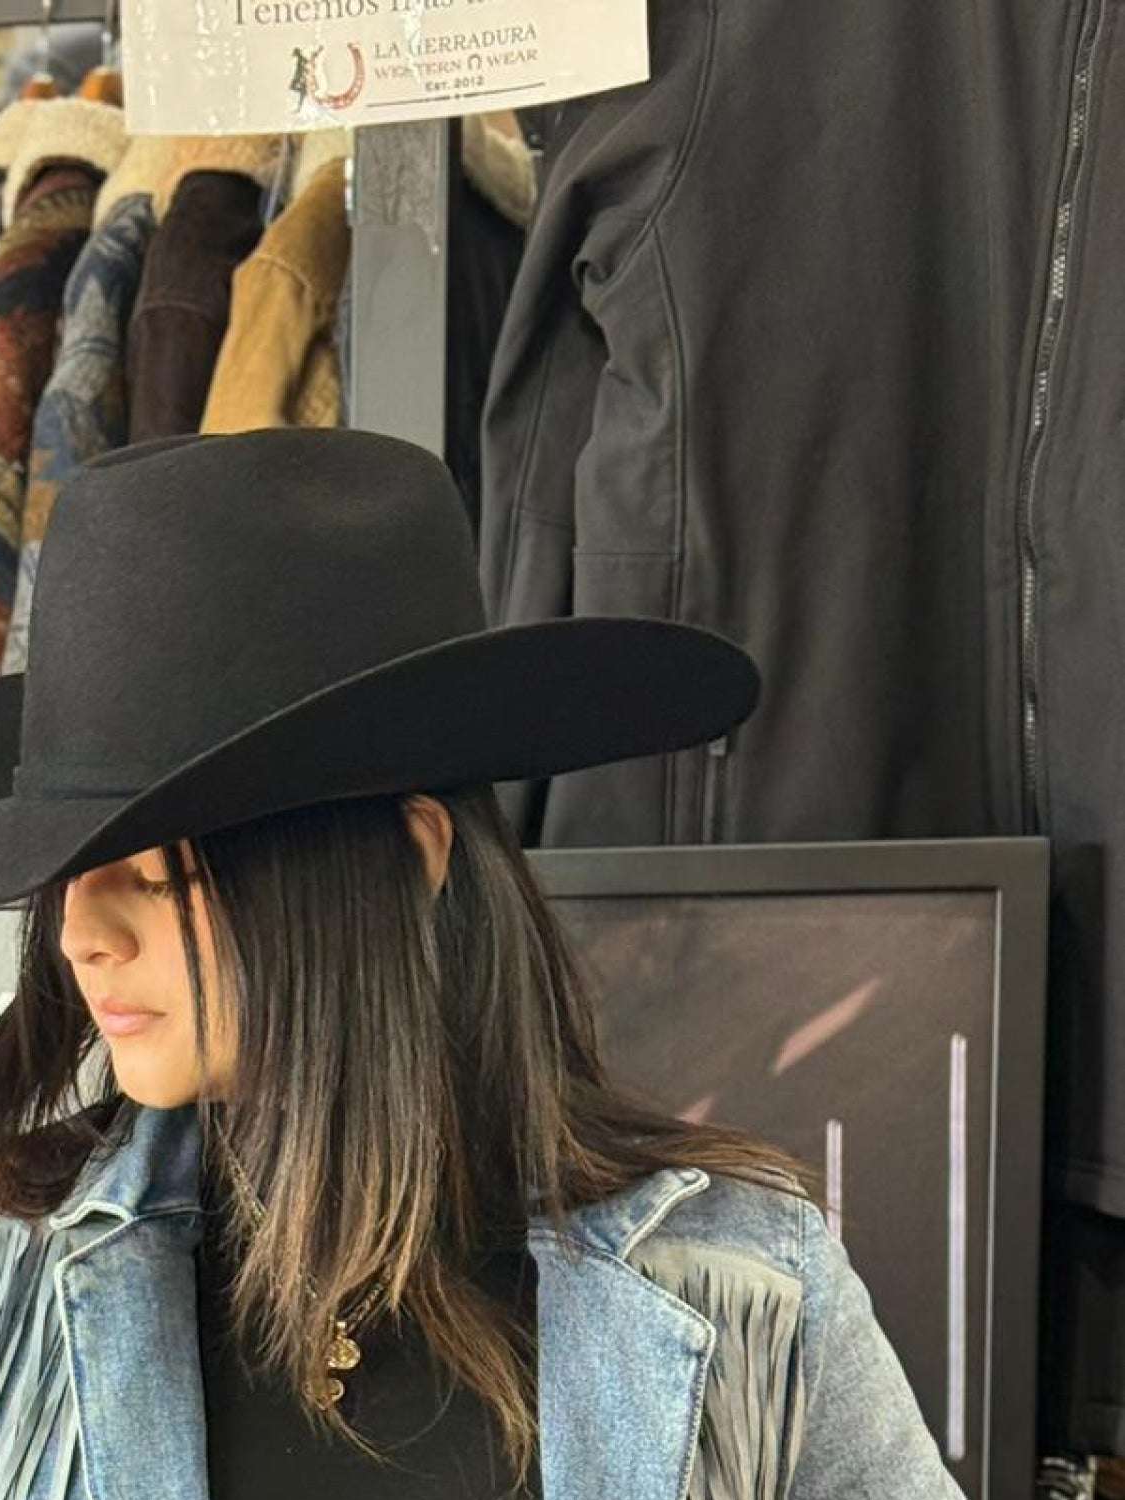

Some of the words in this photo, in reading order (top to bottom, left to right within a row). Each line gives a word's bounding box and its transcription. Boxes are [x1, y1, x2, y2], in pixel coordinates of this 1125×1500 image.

[226, 0, 379, 25] Tenemos
[374, 42, 401, 59] LA
[374, 59, 462, 79] WESTERN
[486, 49, 538, 67] WEAR
[454, 75, 485, 89] 2012
